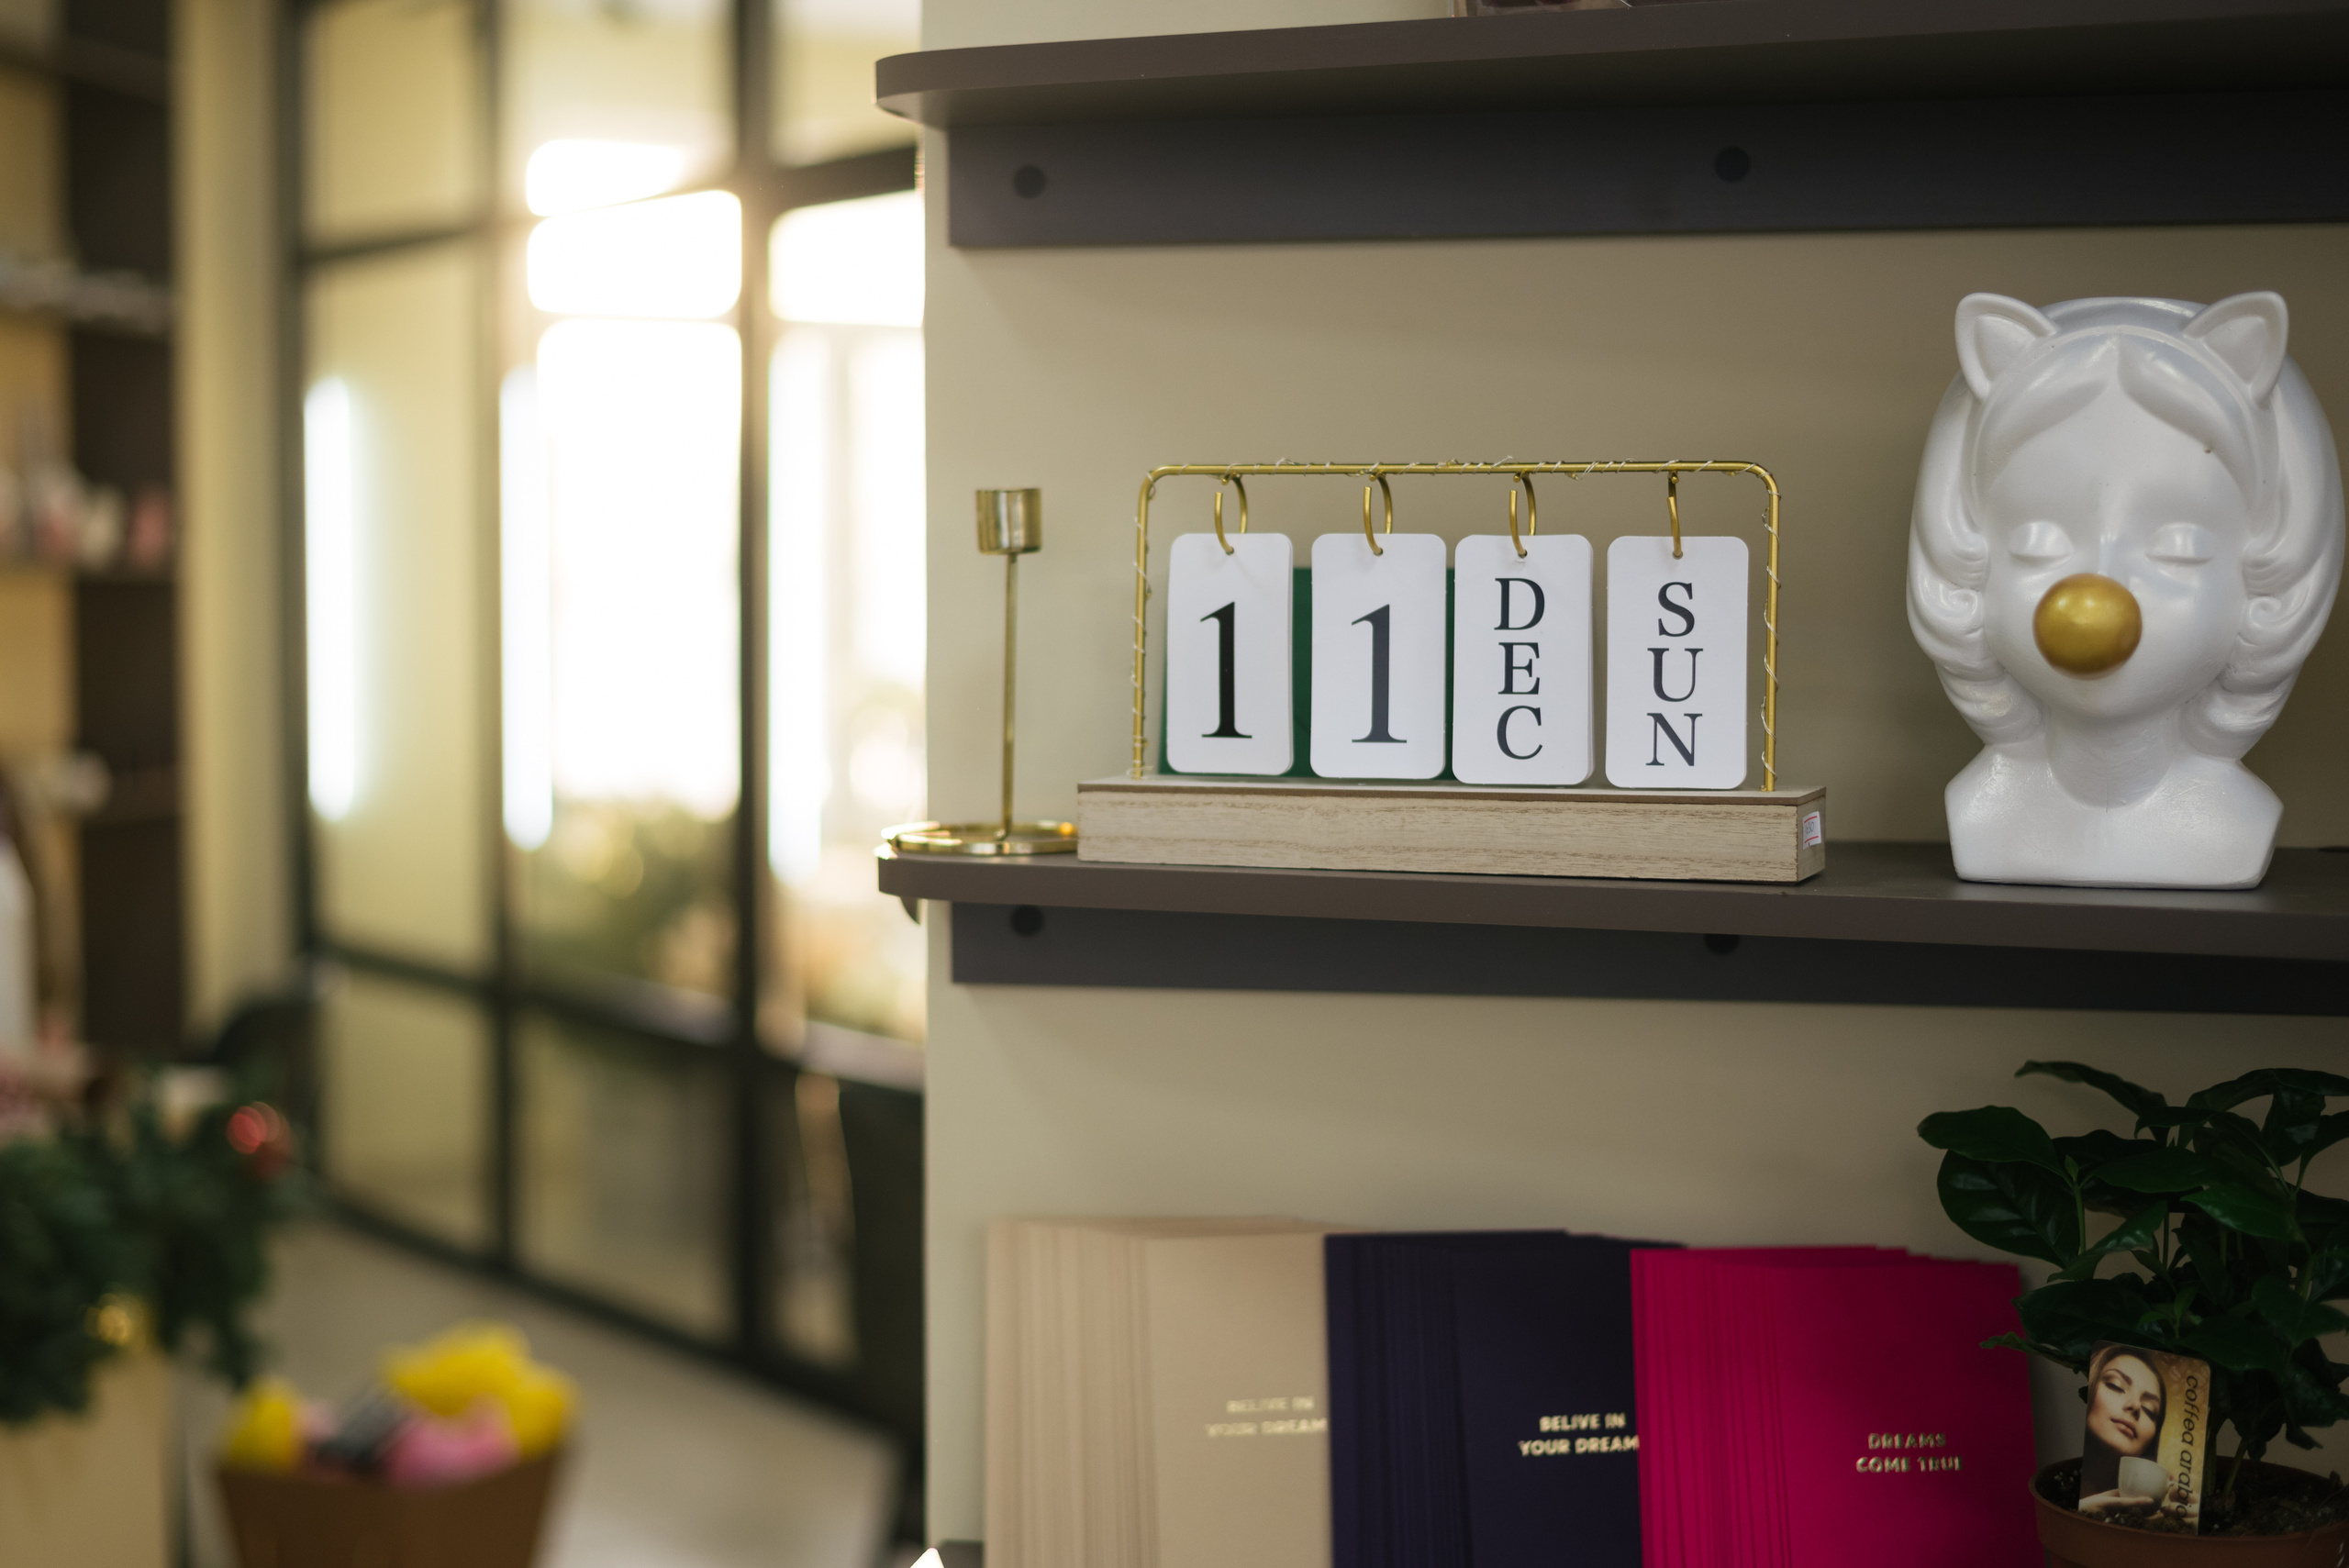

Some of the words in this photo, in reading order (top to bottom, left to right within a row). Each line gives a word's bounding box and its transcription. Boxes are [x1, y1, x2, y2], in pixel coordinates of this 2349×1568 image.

[2181, 1374, 2199, 1447] coffea
[1205, 1421, 1258, 1438] YOUR
[1539, 1414, 1600, 1432] BELIVE
[1604, 1412, 1625, 1429] IN
[1518, 1439, 1571, 1457] YOUR
[1867, 1432, 1946, 1450] DREAMS
[1855, 1456, 1911, 1473] COME
